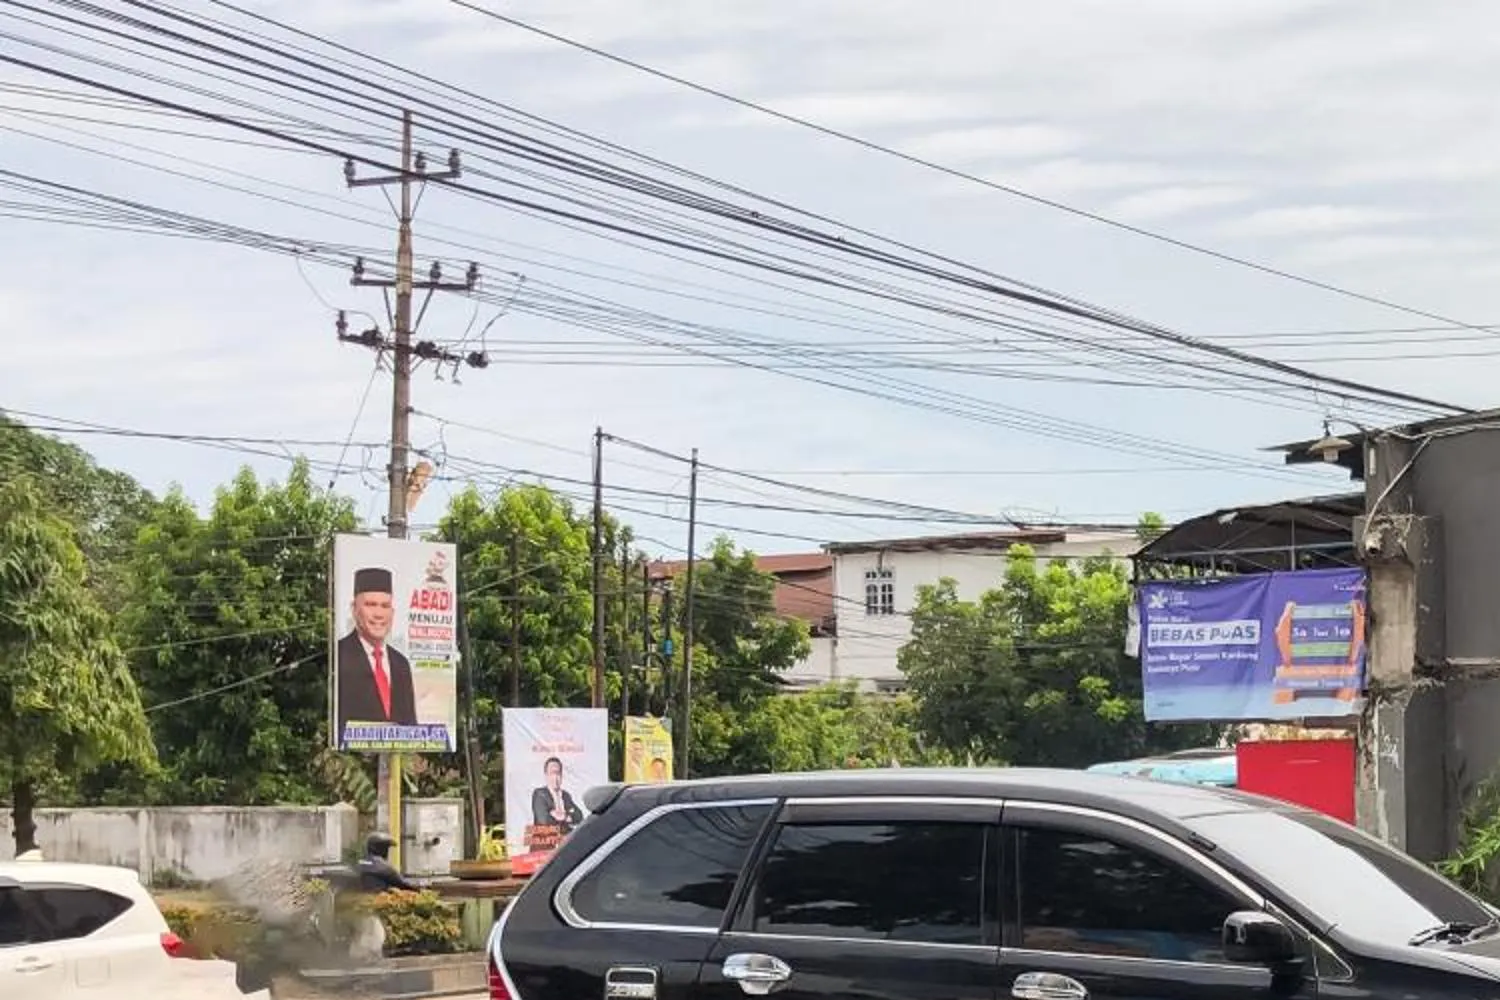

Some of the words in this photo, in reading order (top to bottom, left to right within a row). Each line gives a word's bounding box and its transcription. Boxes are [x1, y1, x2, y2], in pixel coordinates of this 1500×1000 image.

[409, 588, 453, 611] ABADI
[408, 612, 453, 625] MENUJU
[1151, 627, 1205, 642] BEBAS
